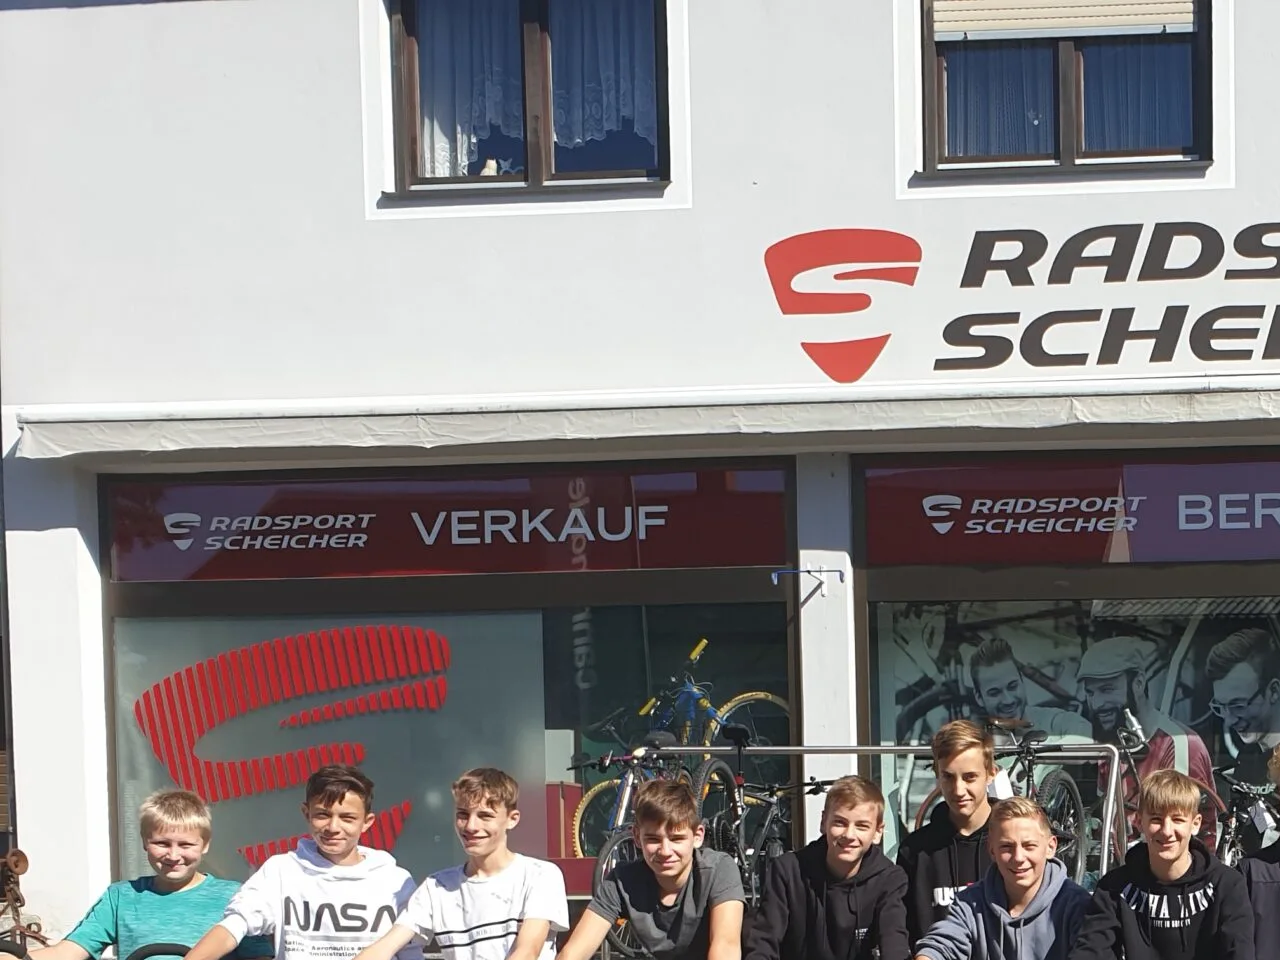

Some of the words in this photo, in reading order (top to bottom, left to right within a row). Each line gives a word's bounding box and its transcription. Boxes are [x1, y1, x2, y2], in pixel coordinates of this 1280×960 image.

[970, 496, 1147, 515] RADSPORT
[210, 513, 376, 531] RADSPORT
[411, 505, 669, 546] VERKAUF
[964, 517, 1138, 534] SCHEICHER
[204, 533, 369, 551] SCHEICHER
[284, 896, 398, 933] NASA
